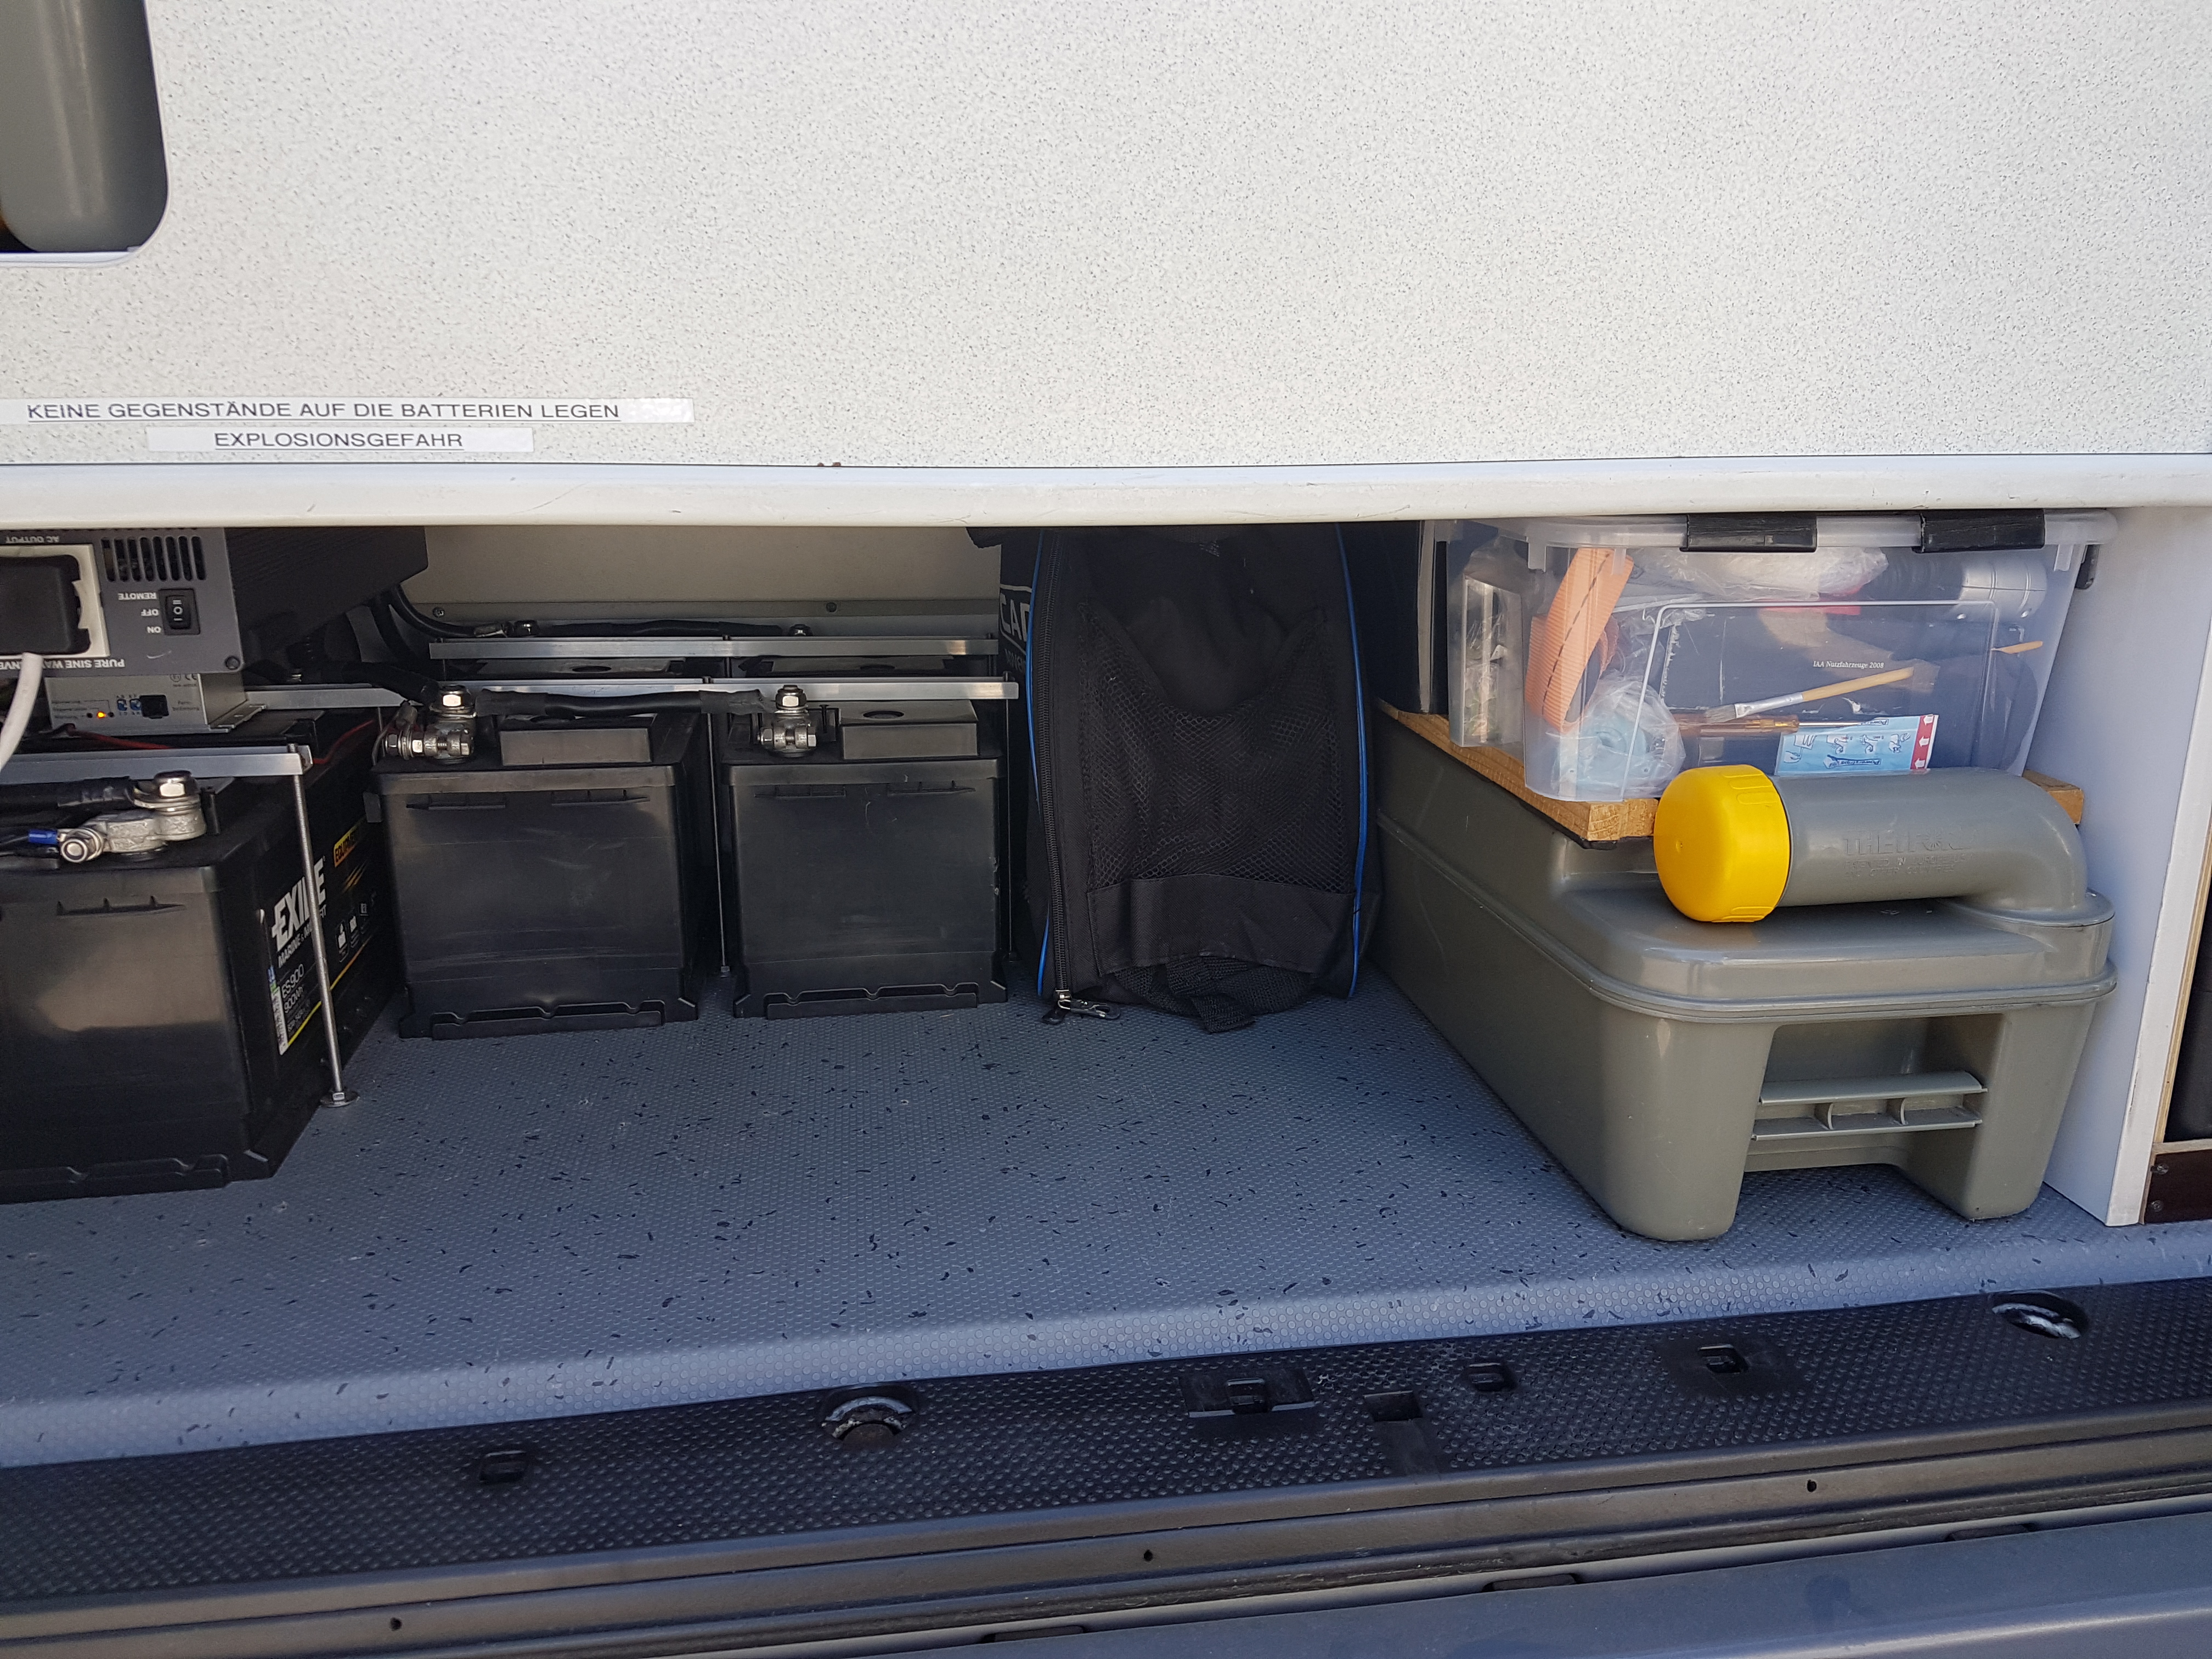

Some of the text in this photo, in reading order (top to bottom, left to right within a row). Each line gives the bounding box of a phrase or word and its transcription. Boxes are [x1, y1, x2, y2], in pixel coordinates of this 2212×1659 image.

[27, 401, 619, 419] KEINE GEGENSTÄNDE AUF DIE BATTERIEN LEGEN
[214, 432, 462, 447] EXPLOSIONSGEFAHR
[117, 592, 157, 601] REMOTE
[140, 608, 159, 617] OFF
[42, 660, 64, 669] WA
[65, 659, 93, 669] SINE
[94, 659, 125, 668] PURE
[1826, 661, 1868, 669] Nutzfahrzeuge
[282, 964, 304, 998] ES900
